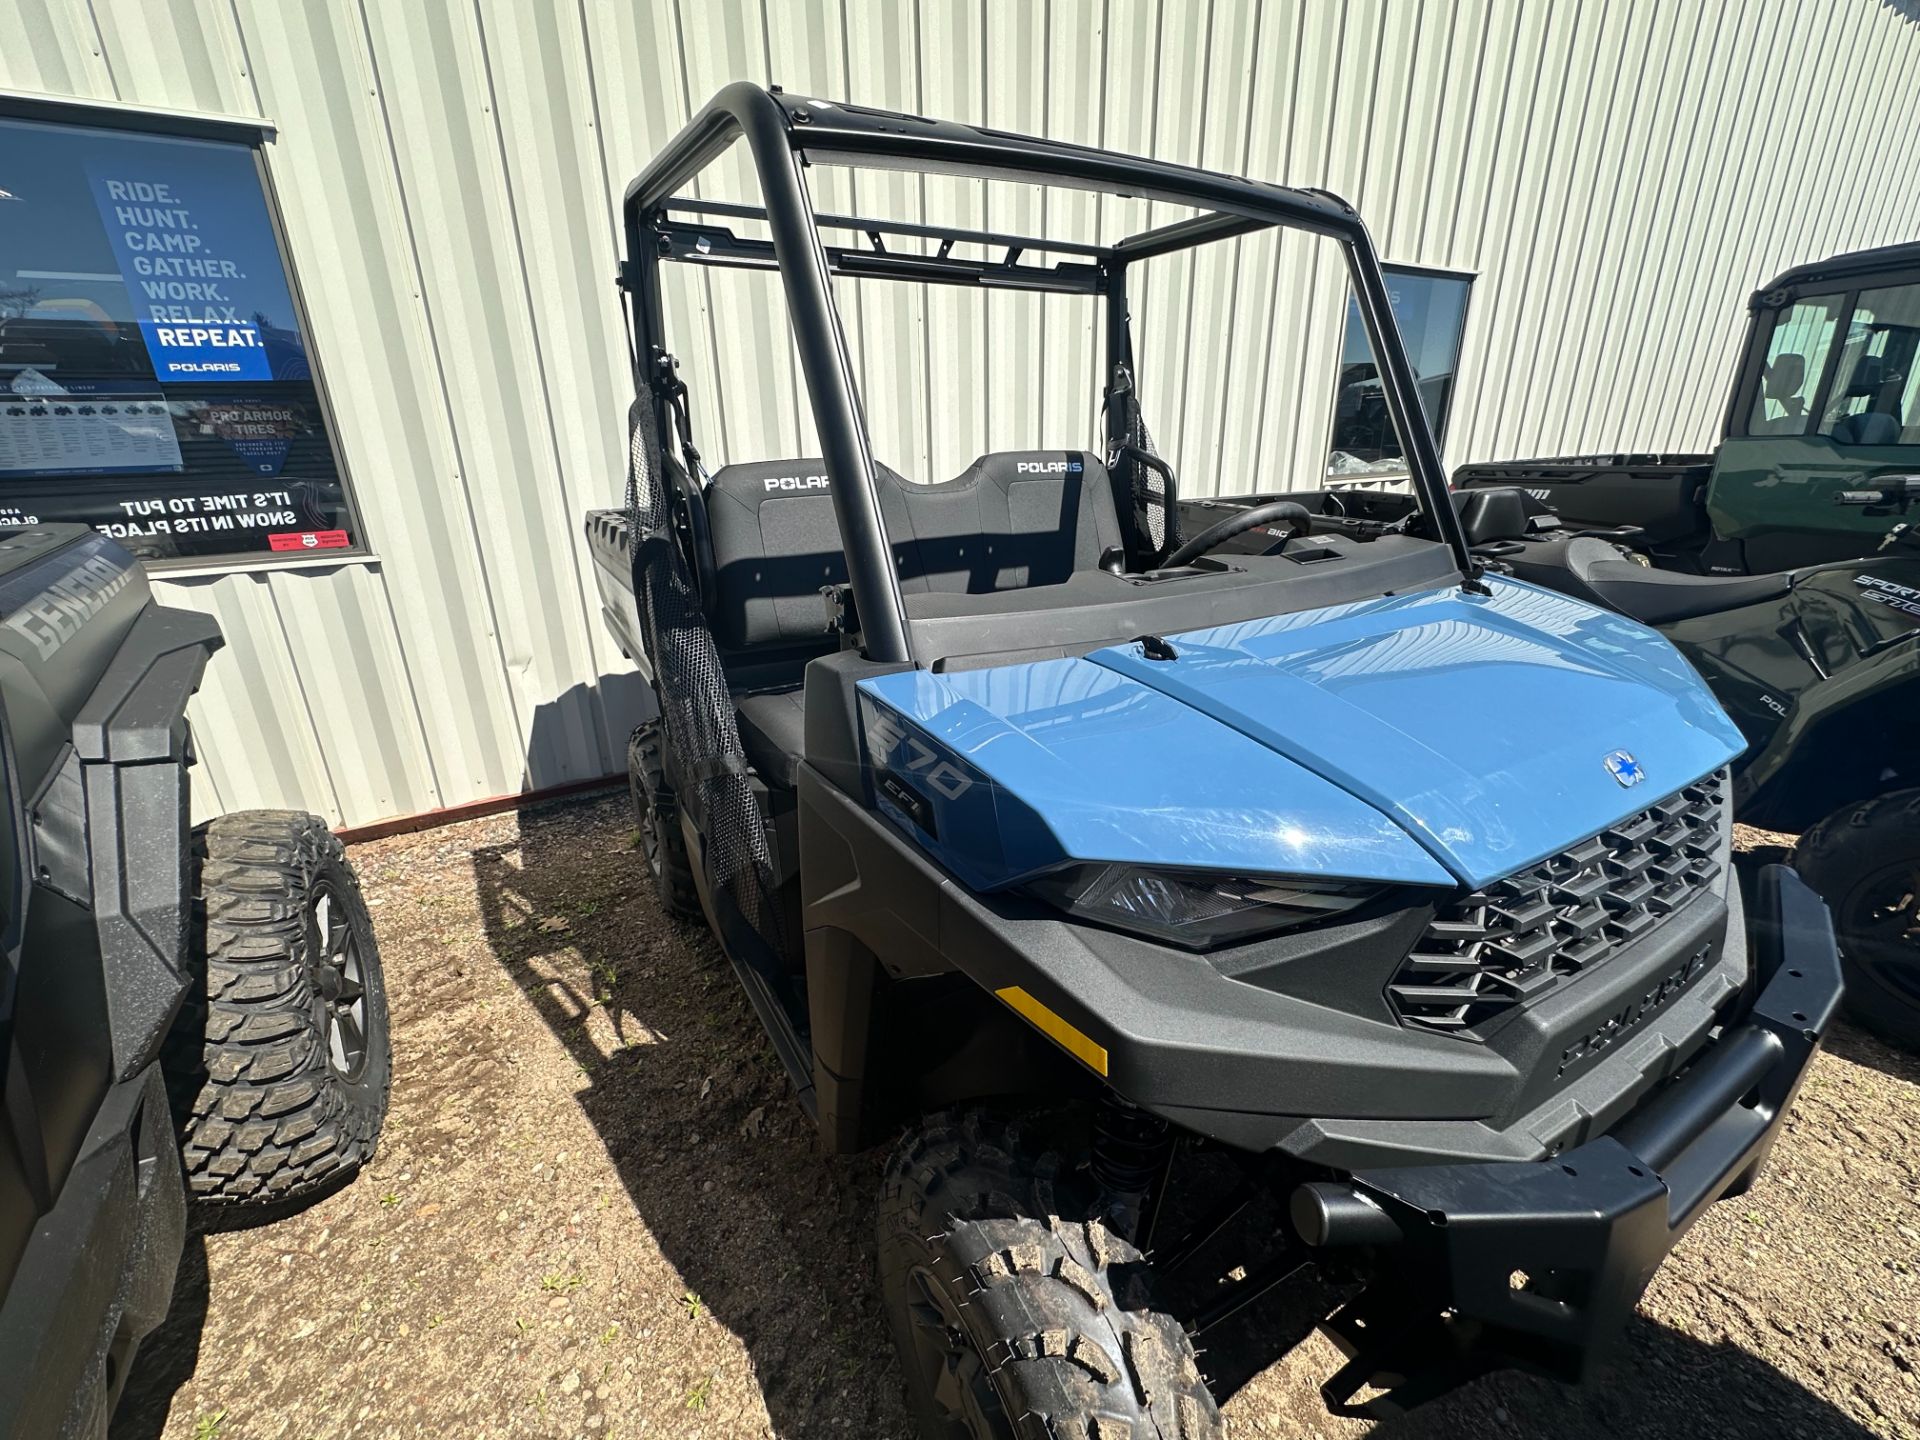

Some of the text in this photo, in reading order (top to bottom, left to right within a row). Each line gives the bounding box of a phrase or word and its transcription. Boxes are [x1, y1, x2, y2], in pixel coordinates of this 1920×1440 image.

[106, 180, 181, 204] RIDE.
[115, 206, 198, 230] HUNT.
[125, 231, 211, 254] CAMP.
[133, 256, 246, 279] GATHER.
[140, 281, 229, 302] WORK.
[149, 304, 247, 325] RELAX.
[156, 328, 264, 347] REPEAT.
[168, 363, 241, 372] POLARIS
[210, 410, 292, 421] PRO ARMOR
[233, 424, 276, 434] TIRES
[1017, 462, 1083, 474] POLARIS
[763, 475, 830, 492] POLAR
[1760, 695, 1786, 718] POL
[884, 779, 920, 811] EFI
[1554, 940, 1713, 1082] POLARIS
